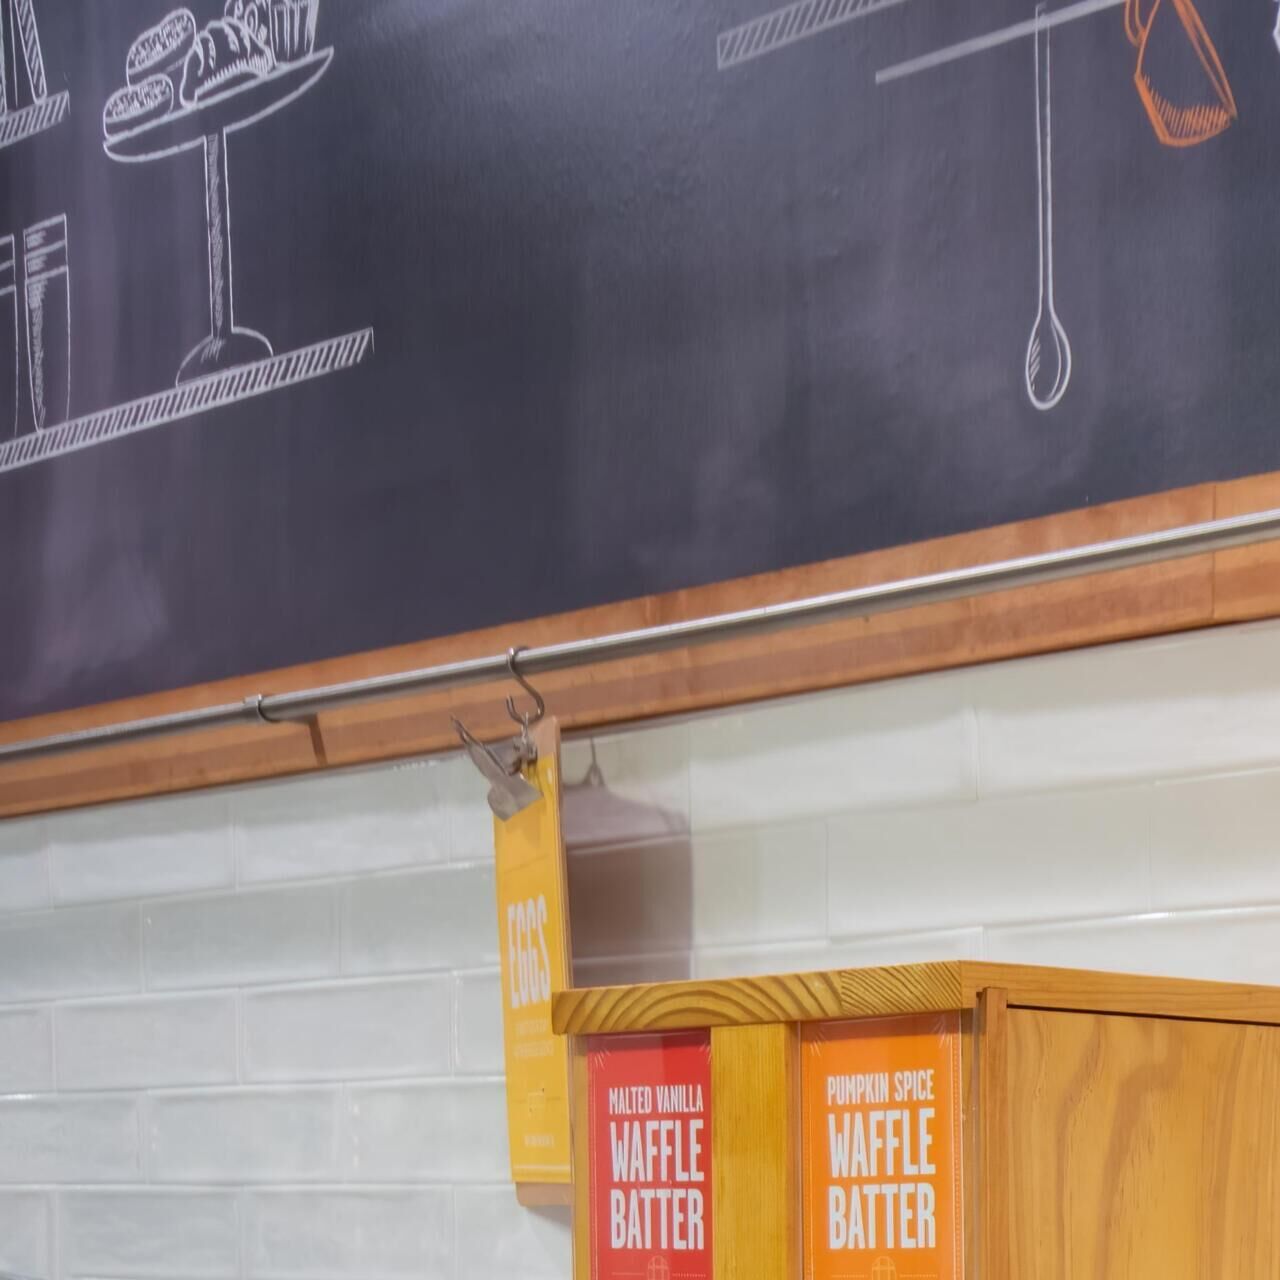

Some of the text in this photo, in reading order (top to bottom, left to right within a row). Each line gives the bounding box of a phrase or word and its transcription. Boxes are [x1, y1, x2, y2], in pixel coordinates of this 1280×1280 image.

[507, 895, 551, 1008] EGGS
[609, 1084, 704, 1115] MALTED VANILLA
[827, 1069, 935, 1106] PUMPKIN SPICE
[610, 1119, 705, 1182] WAFFLE
[828, 1107, 936, 1178] WAFFLE
[610, 1188, 704, 1250] BATTER
[828, 1183, 937, 1250] BATTER
